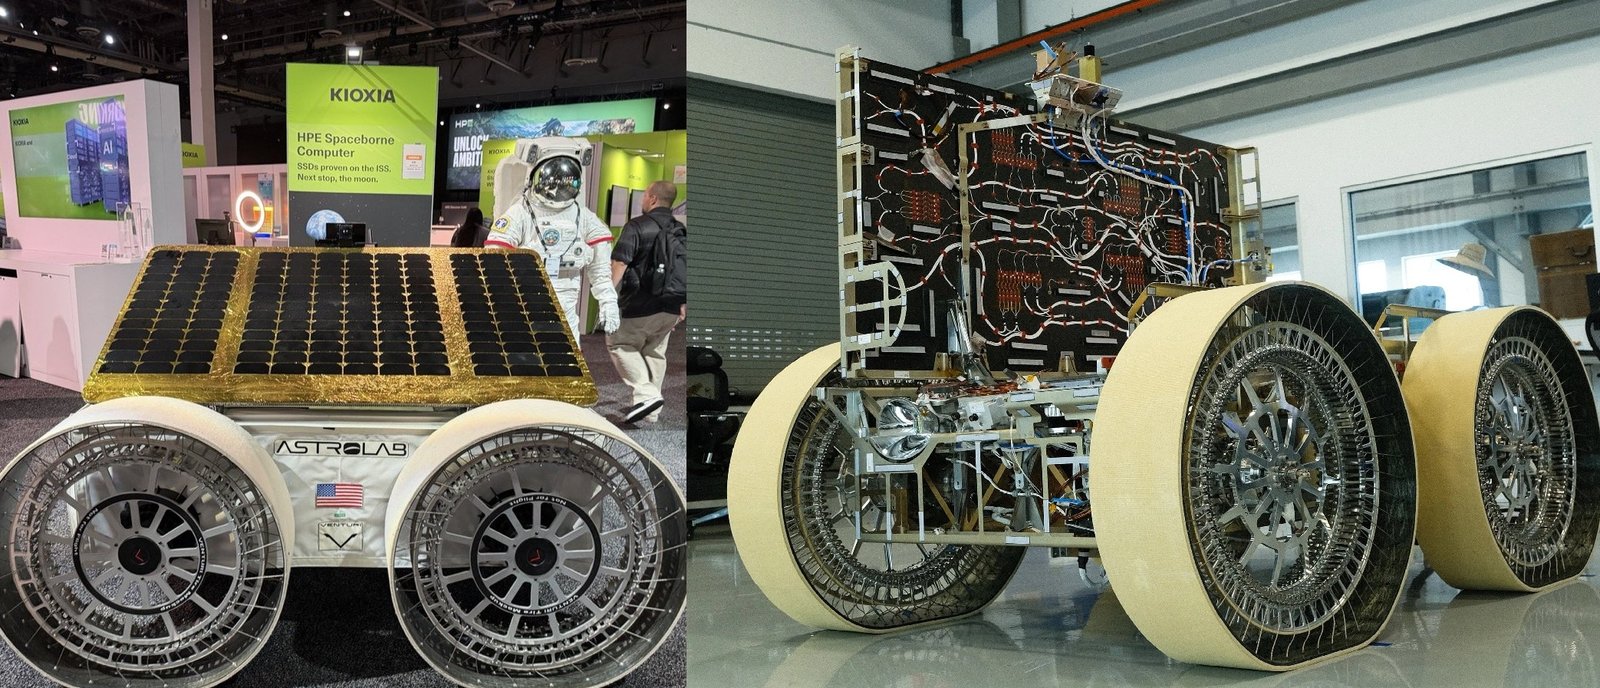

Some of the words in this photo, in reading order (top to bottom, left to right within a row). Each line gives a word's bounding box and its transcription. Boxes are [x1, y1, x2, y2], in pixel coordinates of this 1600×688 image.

[330, 88, 396, 103] KIOXIA
[455, 119, 473, 128] HPE
[297, 132, 322, 143] HPE
[325, 133, 395, 146] Spaceborne
[103, 141, 113, 155] AI
[297, 146, 355, 159] Computer
[297, 162, 319, 171] SSDs
[320, 164, 348, 173] proven
[361, 164, 374, 172] the
[376, 165, 392, 173] ISS.
[297, 173, 316, 182] Next
[317, 174, 337, 183] stop,
[339, 174, 352, 182] the
[276, 440, 407, 456] ASTROLAB
[198, 536, 206, 574] VENTURI
[190, 575, 202, 591] Tire
[489, 594, 521, 614] Mockup
[544, 594, 579, 614] VENTURI
